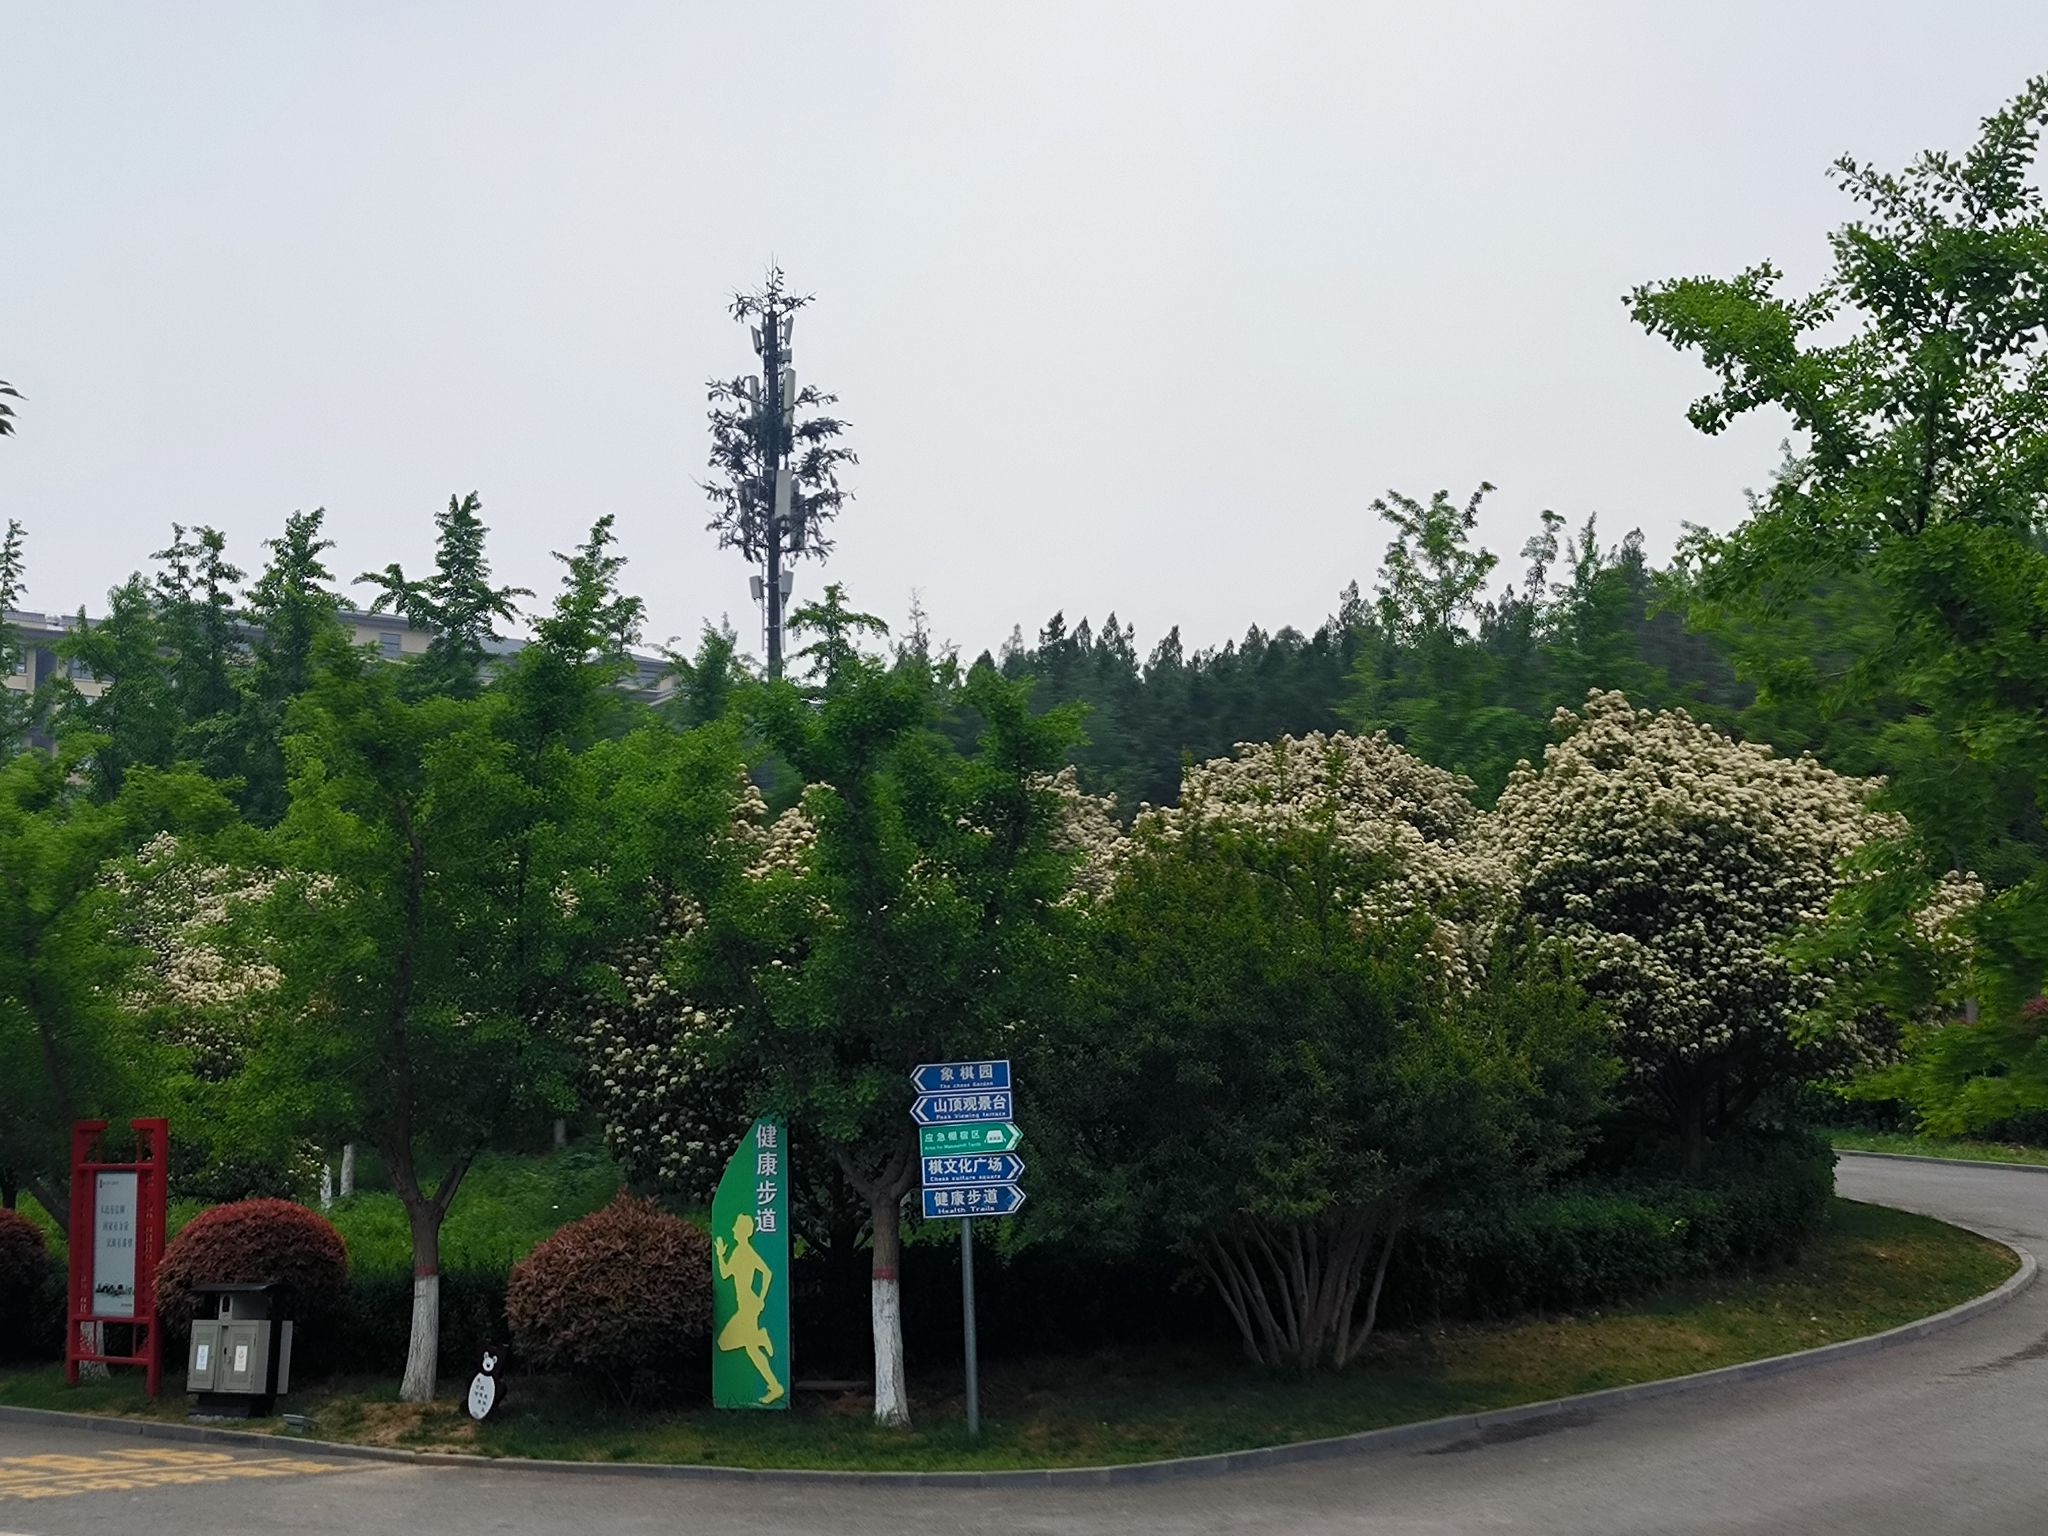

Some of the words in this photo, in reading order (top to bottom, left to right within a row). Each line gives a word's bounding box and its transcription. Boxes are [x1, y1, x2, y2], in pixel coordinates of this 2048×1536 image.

[940, 1064, 993, 1081] 象棋园
[934, 1095, 1006, 1112] 山顶观景台
[928, 1157, 1003, 1175] 棋文化广场
[755, 1124, 778, 1232] 健康步道
[934, 1188, 998, 1207] 健康步道
